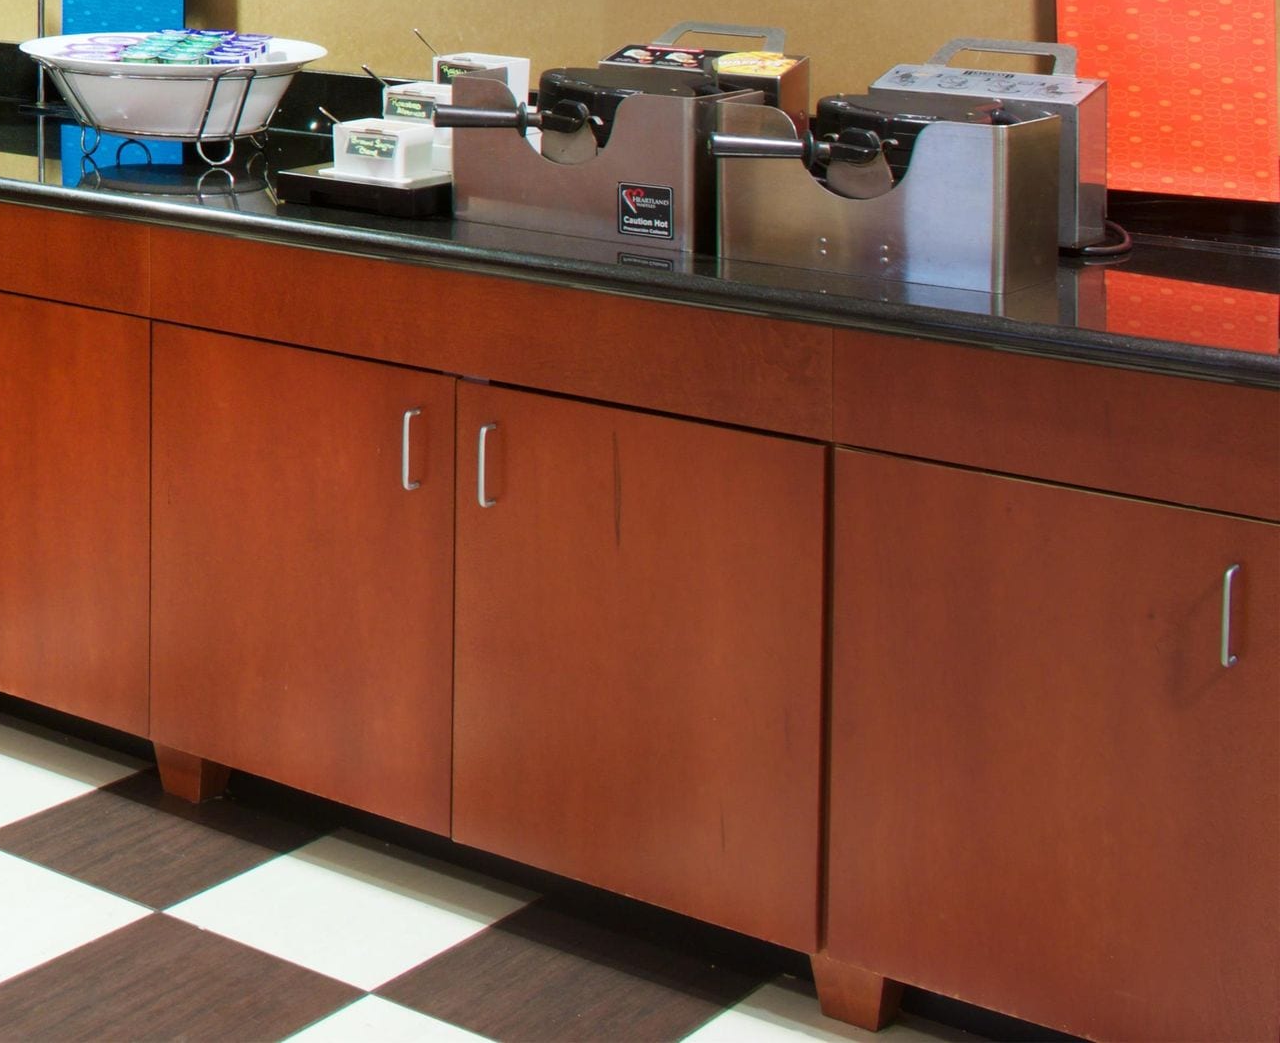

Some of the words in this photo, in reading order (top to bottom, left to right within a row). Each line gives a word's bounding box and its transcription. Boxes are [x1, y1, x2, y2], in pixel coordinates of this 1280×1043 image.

[632, 196, 670, 206] HEARTLAND
[623, 215, 653, 226] Caution
[654, 219, 668, 229] Hot
